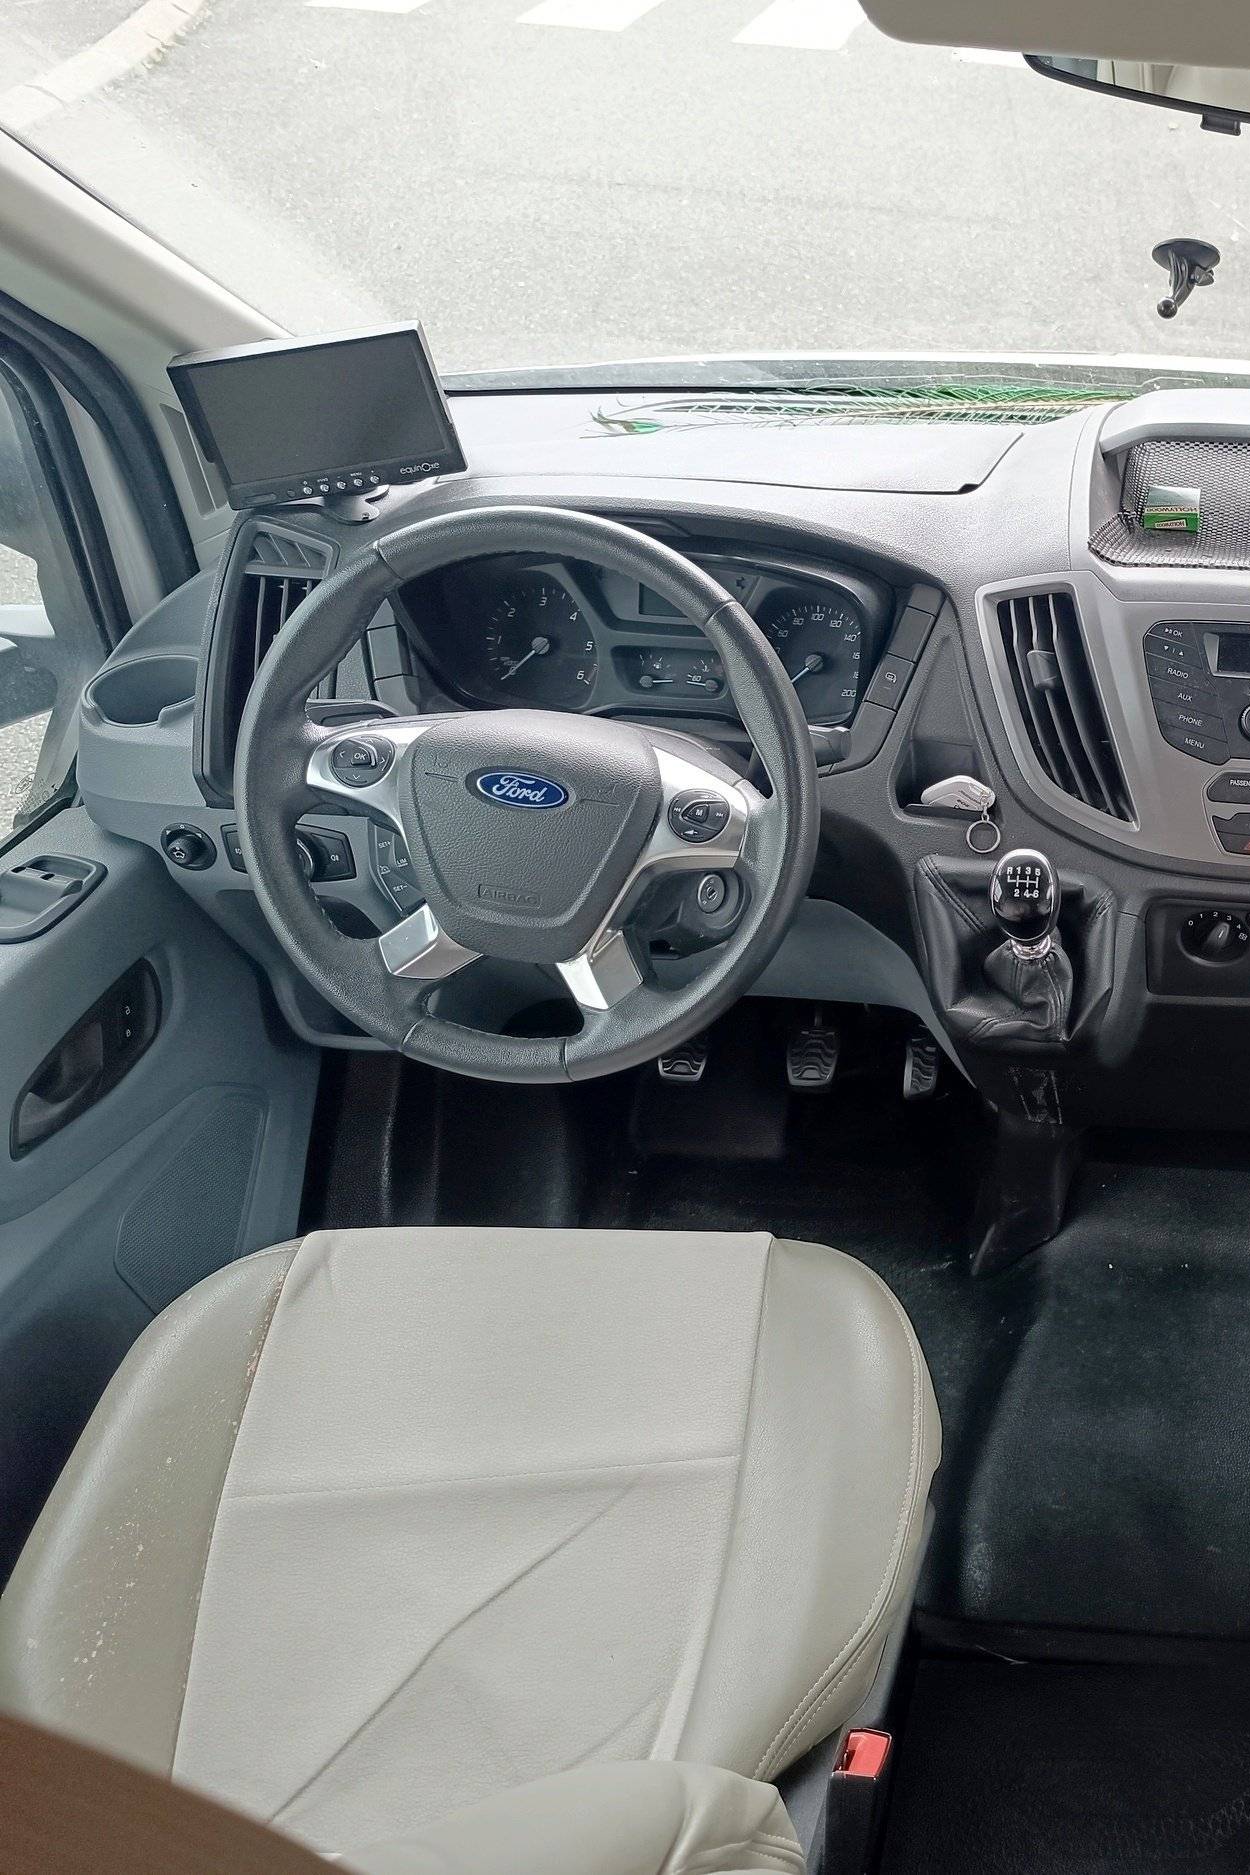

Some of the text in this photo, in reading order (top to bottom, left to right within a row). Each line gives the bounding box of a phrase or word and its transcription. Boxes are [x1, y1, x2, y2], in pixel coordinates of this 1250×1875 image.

[539, 597, 547, 606] 3
[508, 607, 516, 617] 2
[569, 611, 578, 621] 4
[829, 620, 842, 628] 120
[844, 634, 857, 642] 140
[585, 641, 594, 651] 5
[576, 670, 585, 680] 6
[1167, 667, 1189, 679] RADIO
[841, 689, 857, 697] 200
[1178, 692, 1193, 702] AUX
[1178, 714, 1203, 727] PHONE
[1184, 737, 1205, 749] MENU
[354, 752, 367, 761] OK
[492, 775, 547, 802] Ford
